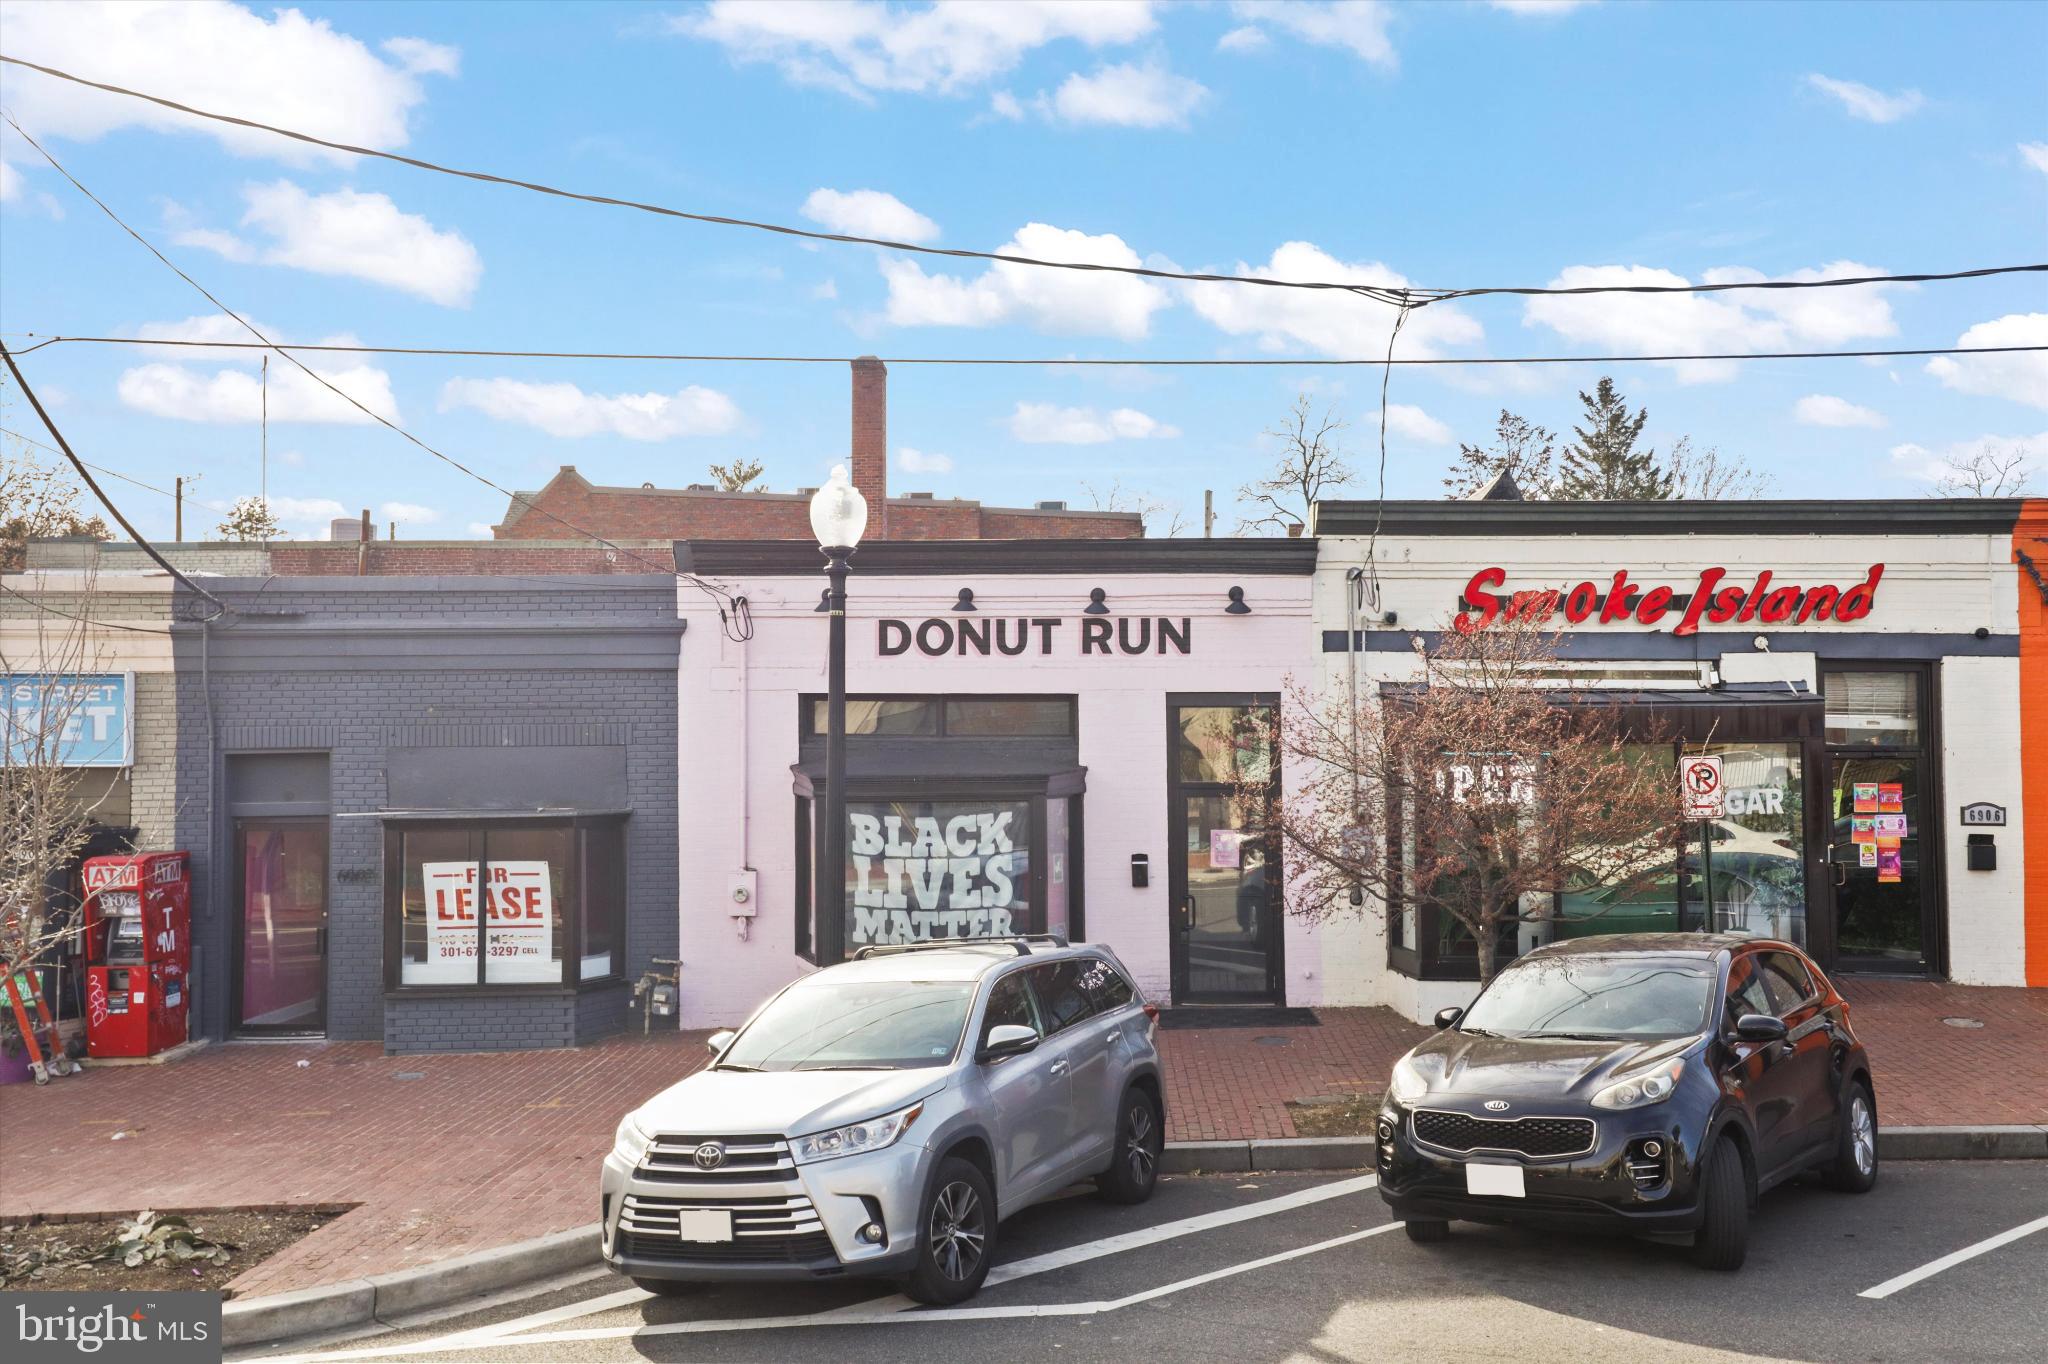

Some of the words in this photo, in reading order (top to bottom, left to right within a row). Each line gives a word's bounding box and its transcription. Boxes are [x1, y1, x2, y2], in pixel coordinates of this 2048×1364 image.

[1453, 566, 1673, 633] Smoke
[1673, 562, 1885, 636] Island
[877, 617, 1062, 657] DONUT
[1081, 617, 1192, 655] RUN
[15, 684, 118, 702] STREET
[1724, 788, 1785, 816] GAR
[1969, 809, 2001, 822] 6906
[850, 811, 1013, 858] BLACK
[92, 867, 137, 885] ATM
[155, 862, 180, 883] ATM
[852, 853, 1014, 910] LIVES
[435, 886, 544, 921] LEASE
[852, 906, 1015, 944] MATTER
[440, 945, 519, 958] 301-67-3297
